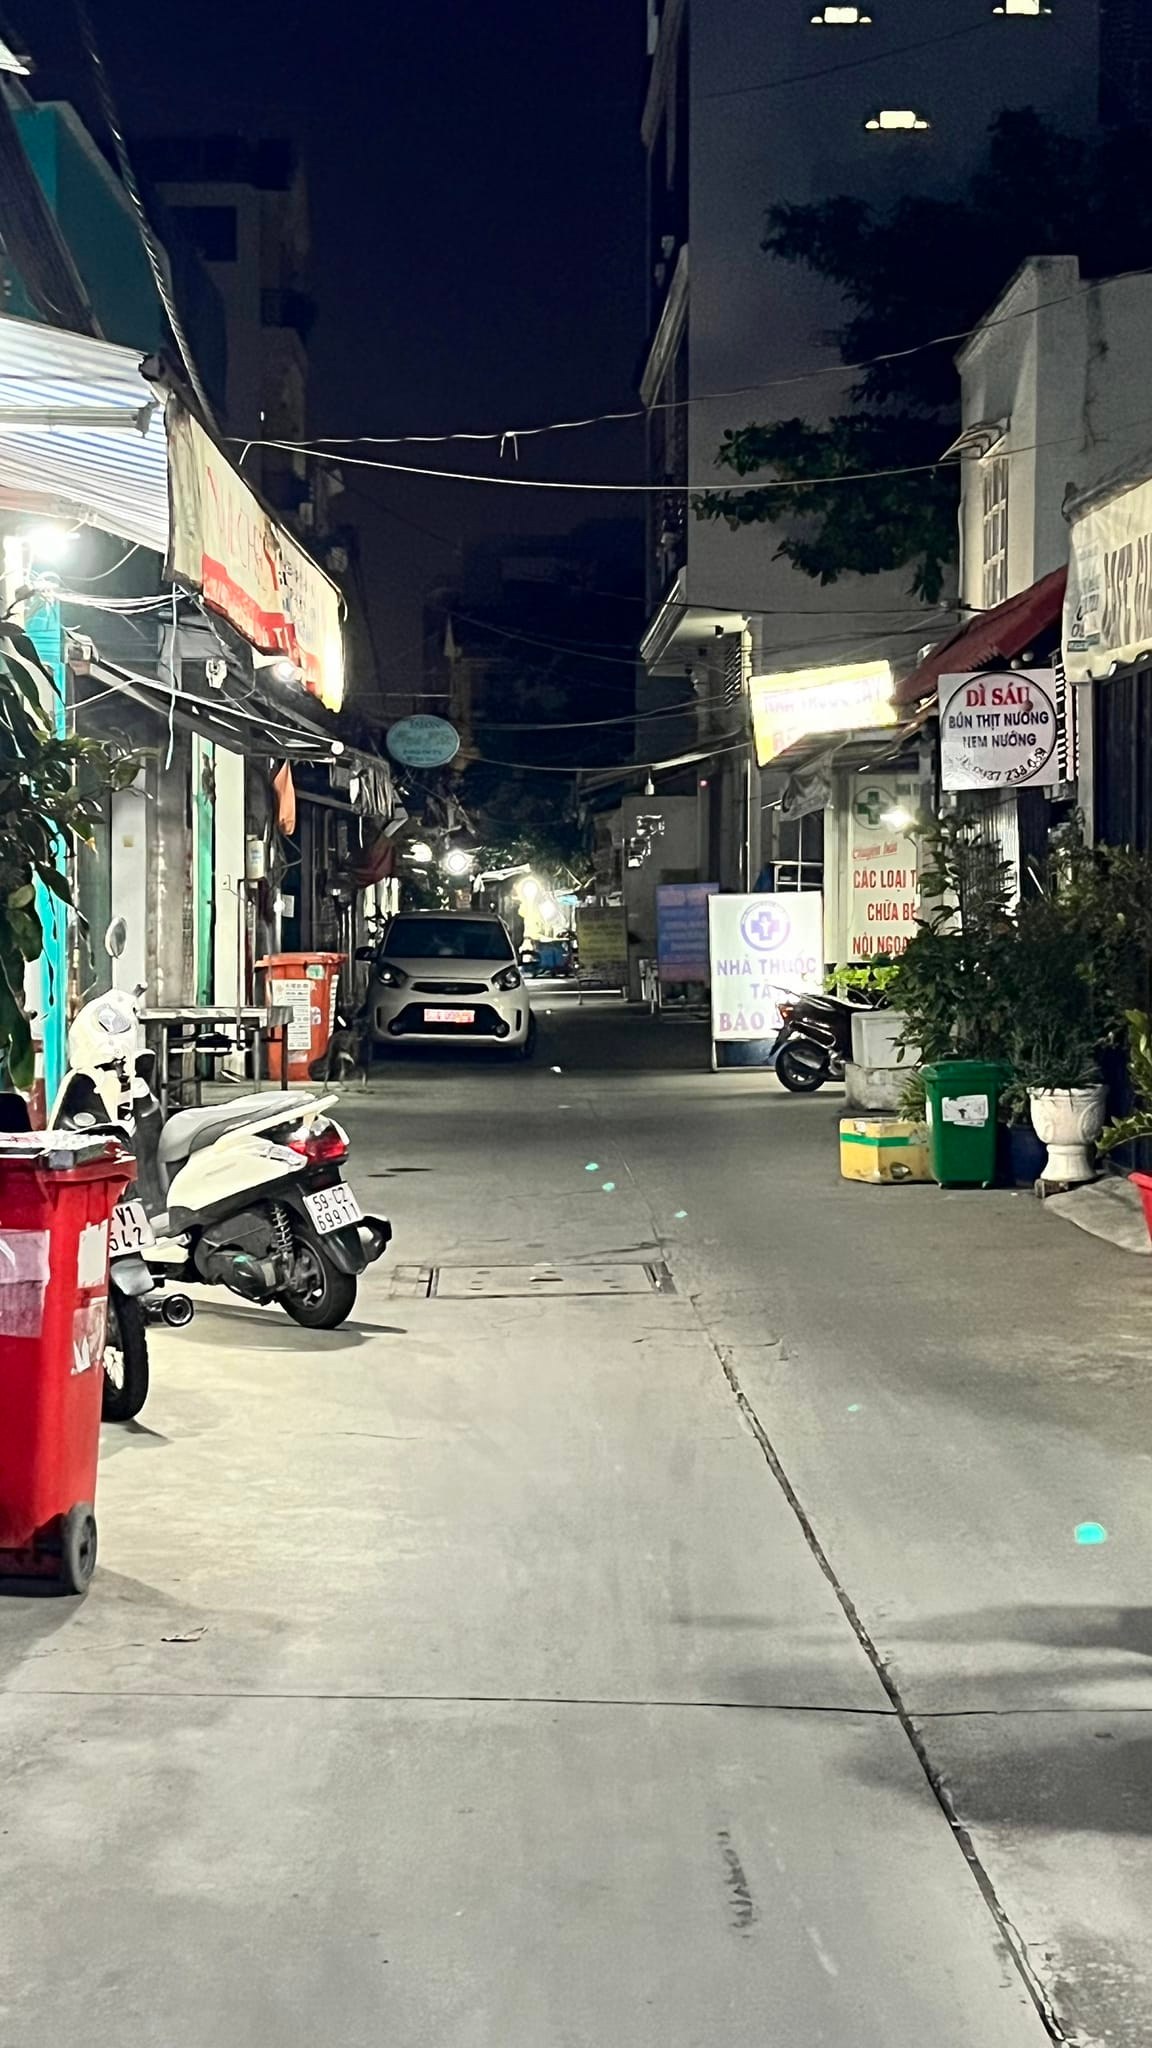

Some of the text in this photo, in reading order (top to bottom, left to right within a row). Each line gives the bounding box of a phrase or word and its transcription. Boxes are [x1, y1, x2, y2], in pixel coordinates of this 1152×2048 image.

[966, 682, 1030, 707] DÌ SÁU
[949, 712, 973, 729] BÚN
[976, 713, 1001, 730] THỊT
[963, 730, 1037, 748] NEM NƯỚNG
[853, 867, 877, 888] CÁC
[881, 869, 906, 892] LOẠI
[868, 899, 899, 921] CHỮA
[717, 955, 752, 976] NHÀ
[719, 1004, 765, 1032] BẢO
